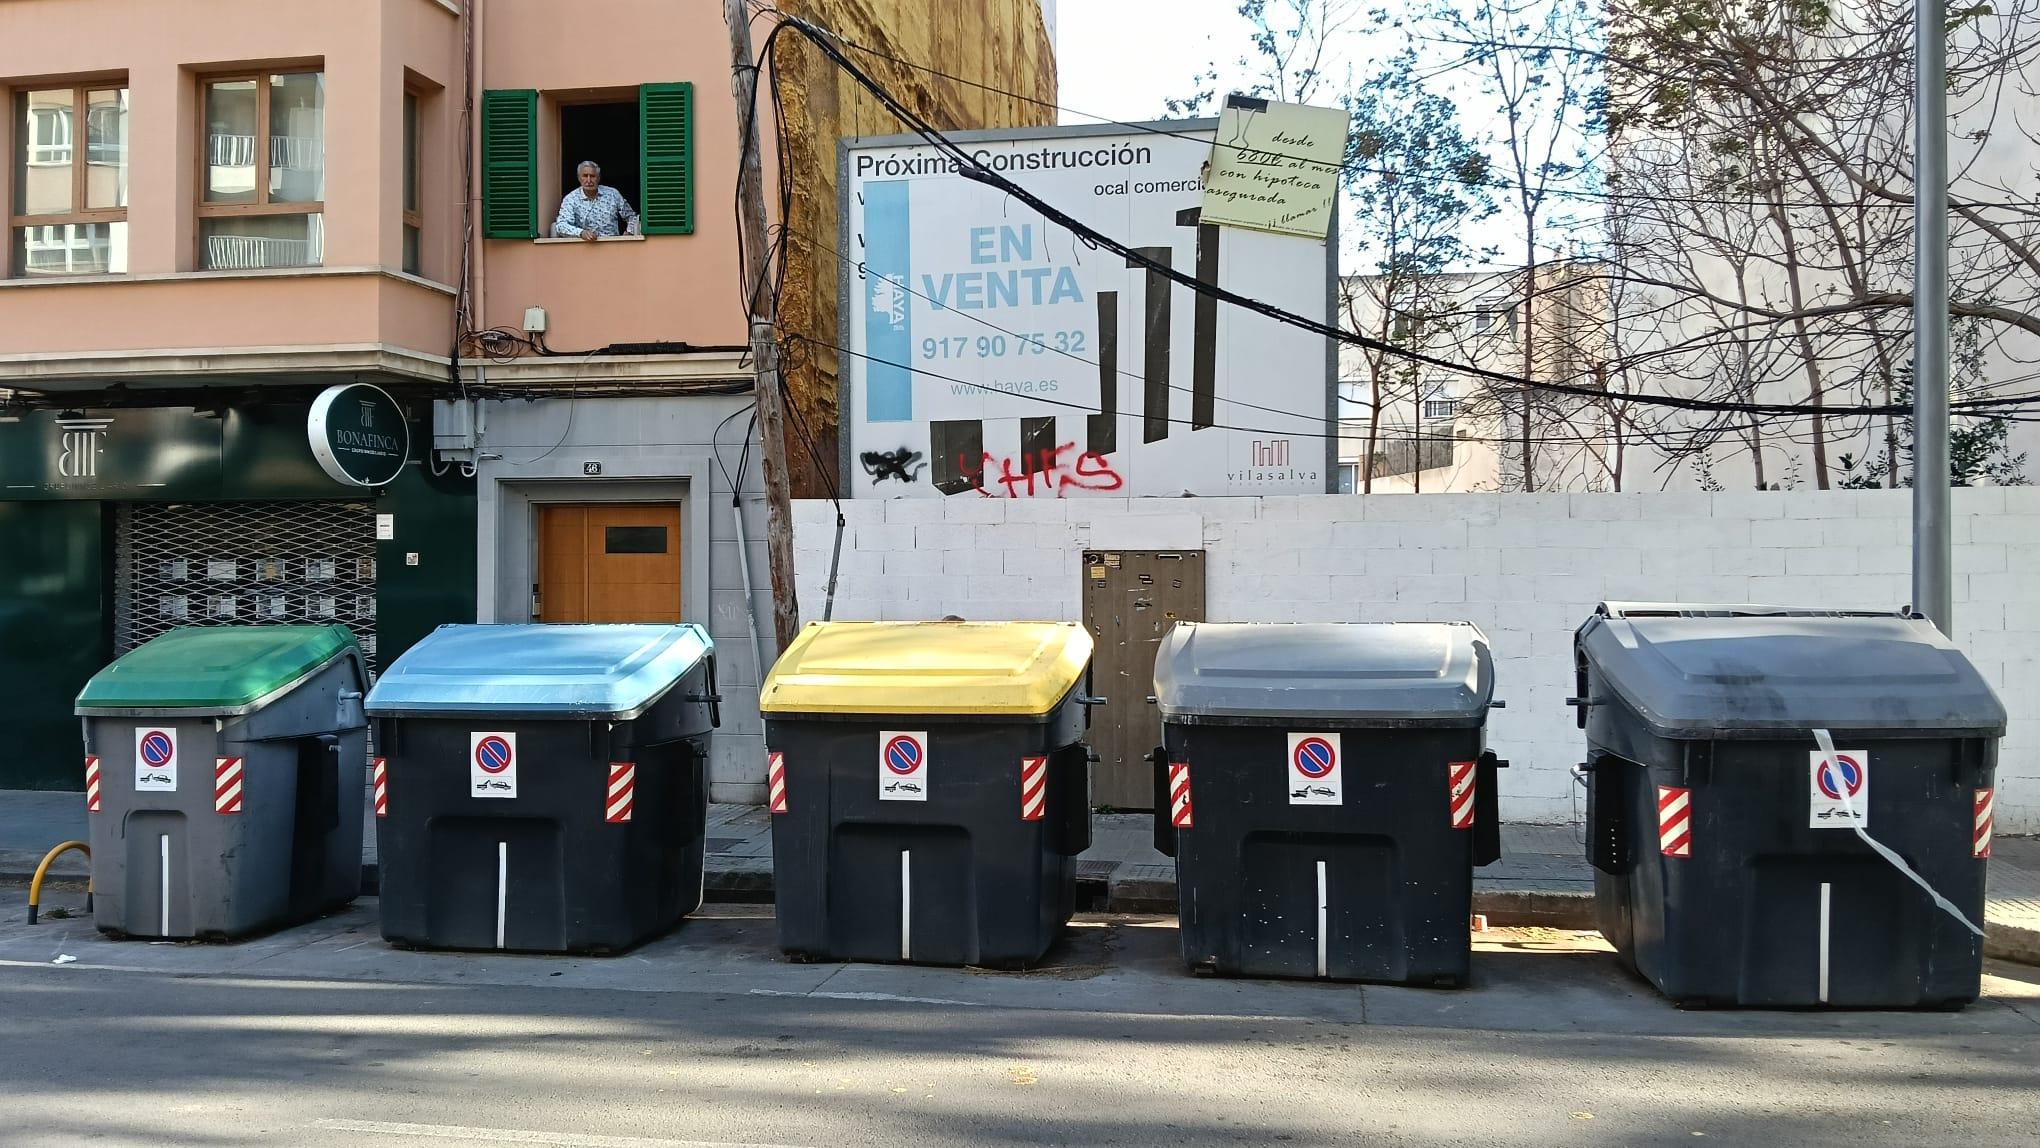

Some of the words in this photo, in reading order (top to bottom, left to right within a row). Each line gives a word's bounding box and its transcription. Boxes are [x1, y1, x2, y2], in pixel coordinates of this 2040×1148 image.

[1272, 131, 1314, 147] desde
[857, 153, 961, 177] Próxima
[973, 142, 1151, 171] Construcción
[1288, 158, 1307, 169] al
[1219, 170, 1247, 179] con
[1253, 169, 1321, 189] hipoteca
[1206, 188, 1287, 205] asegurada
[970, 224, 1032, 265] EN
[921, 266, 1084, 311] VENTA
[893, 274, 905, 325] HAYA
[922, 336, 968, 360] 917
[976, 335, 1006, 358] 90
[1017, 333, 1045, 356] 75
[1054, 330, 1086, 353] 32
[950, 379, 1059, 396] www.haya.es
[336, 429, 399, 451] BONAFINCA
[1227, 468, 1317, 481] vilasalva
